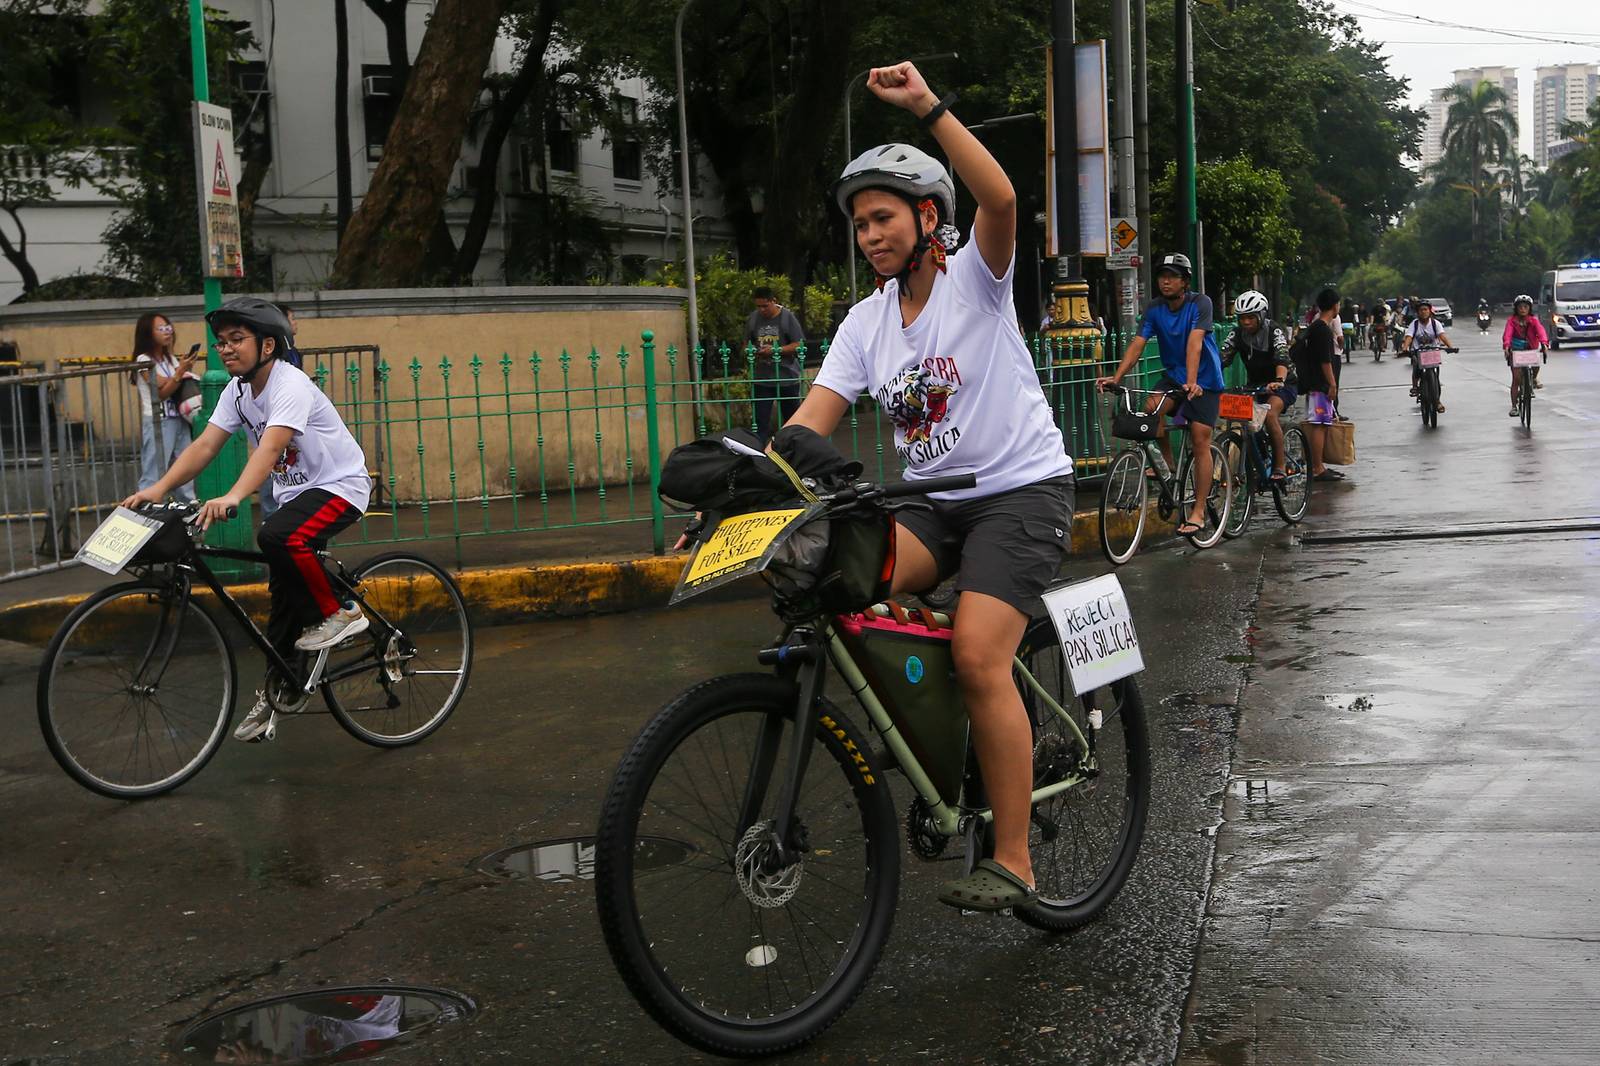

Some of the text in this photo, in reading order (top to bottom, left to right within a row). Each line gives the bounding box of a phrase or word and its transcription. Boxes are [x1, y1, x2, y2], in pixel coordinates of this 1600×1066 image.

[201, 113, 231, 131] SLOW DOWN
[915, 427, 960, 463] SILICA
[109, 526, 135, 544] REJECT
[714, 515, 792, 540] PHILIPPINES
[721, 530, 751, 549] NOT
[698, 538, 763, 570] FOR SALE!
[1063, 592, 1116, 636] REJECT
[1064, 618, 1138, 670] PAX SILICA!
[820, 716, 876, 785] MAXXIS
